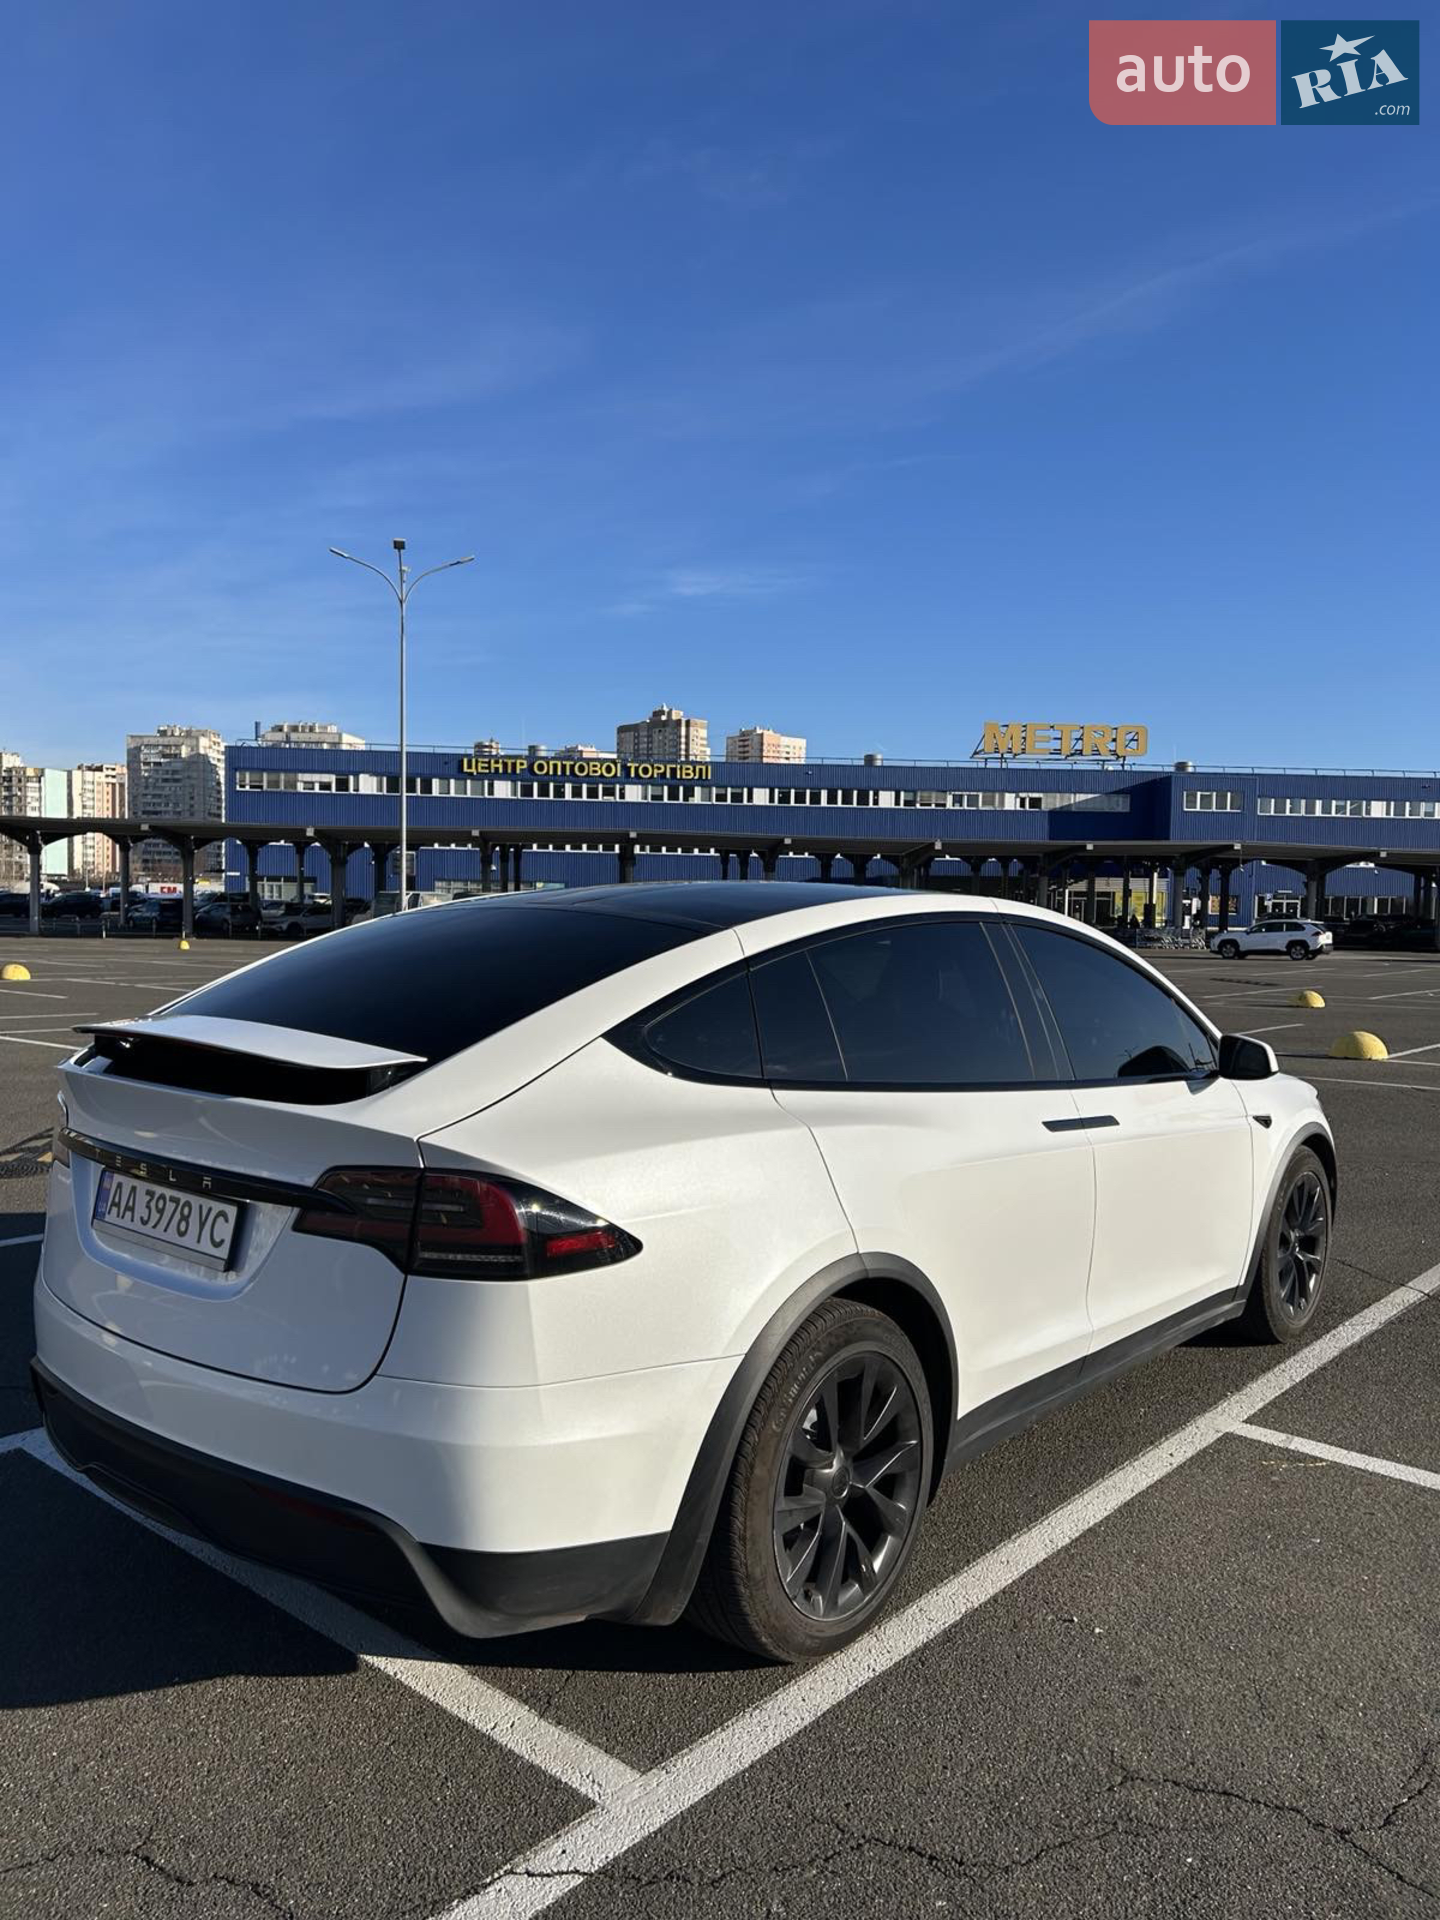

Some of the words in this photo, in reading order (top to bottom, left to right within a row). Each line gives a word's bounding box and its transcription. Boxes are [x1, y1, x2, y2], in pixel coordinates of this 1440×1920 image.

[983, 721, 1149, 757] METRO
[462, 757, 528, 775] ЦЕНТР
[533, 760, 622, 778] ОПТОВОЇ
[627, 763, 712, 780] ТОРГІВЛІ
[107, 1181, 138, 1222] AA
[140, 1189, 193, 1238] 3978
[196, 1203, 230, 1249] YC
